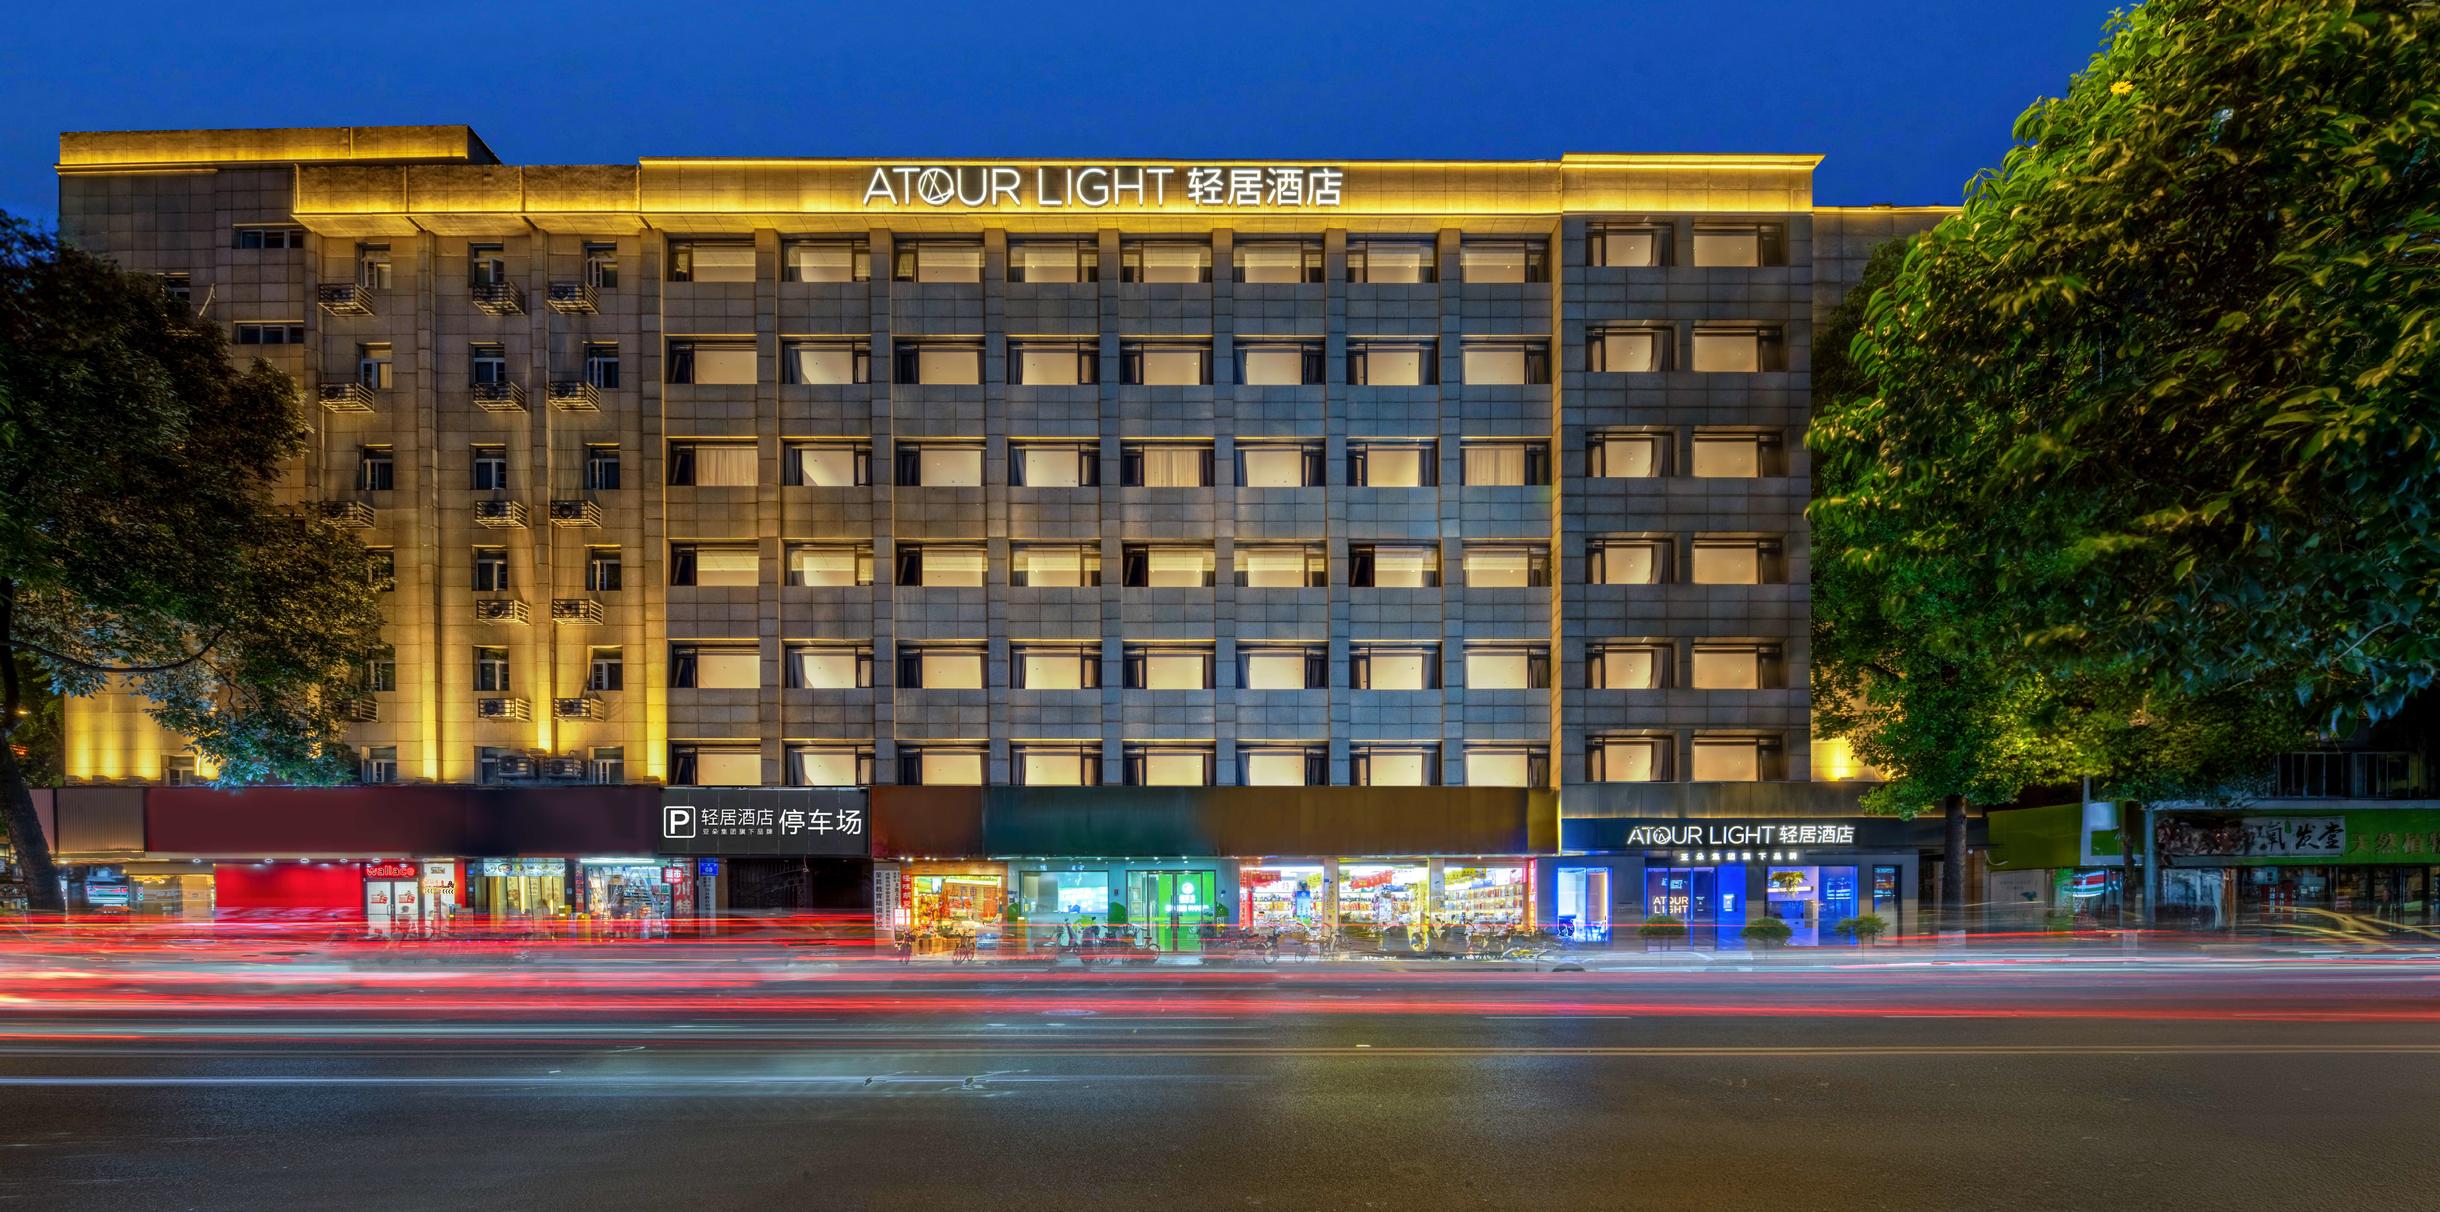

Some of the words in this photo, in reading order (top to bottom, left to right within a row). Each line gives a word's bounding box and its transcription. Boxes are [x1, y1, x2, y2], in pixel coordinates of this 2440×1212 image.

[863, 167, 1021, 207] ATOUR
[1038, 167, 1174, 206] LIGHT
[1187, 166, 1343, 206] 轻居酒店
[700, 808, 774, 827] 轻居酒店
[778, 808, 862, 836] 停车场
[702, 827, 773, 836] 亚朵集团旗下品牌
[1627, 825, 1704, 845] ATOUR
[1709, 825, 1776, 845] LIGHT
[1778, 824, 1856, 845] 轻居酒店
[1679, 852, 1798, 862] 亚朵集团旗下品牌
[366, 864, 415, 876] wallace
